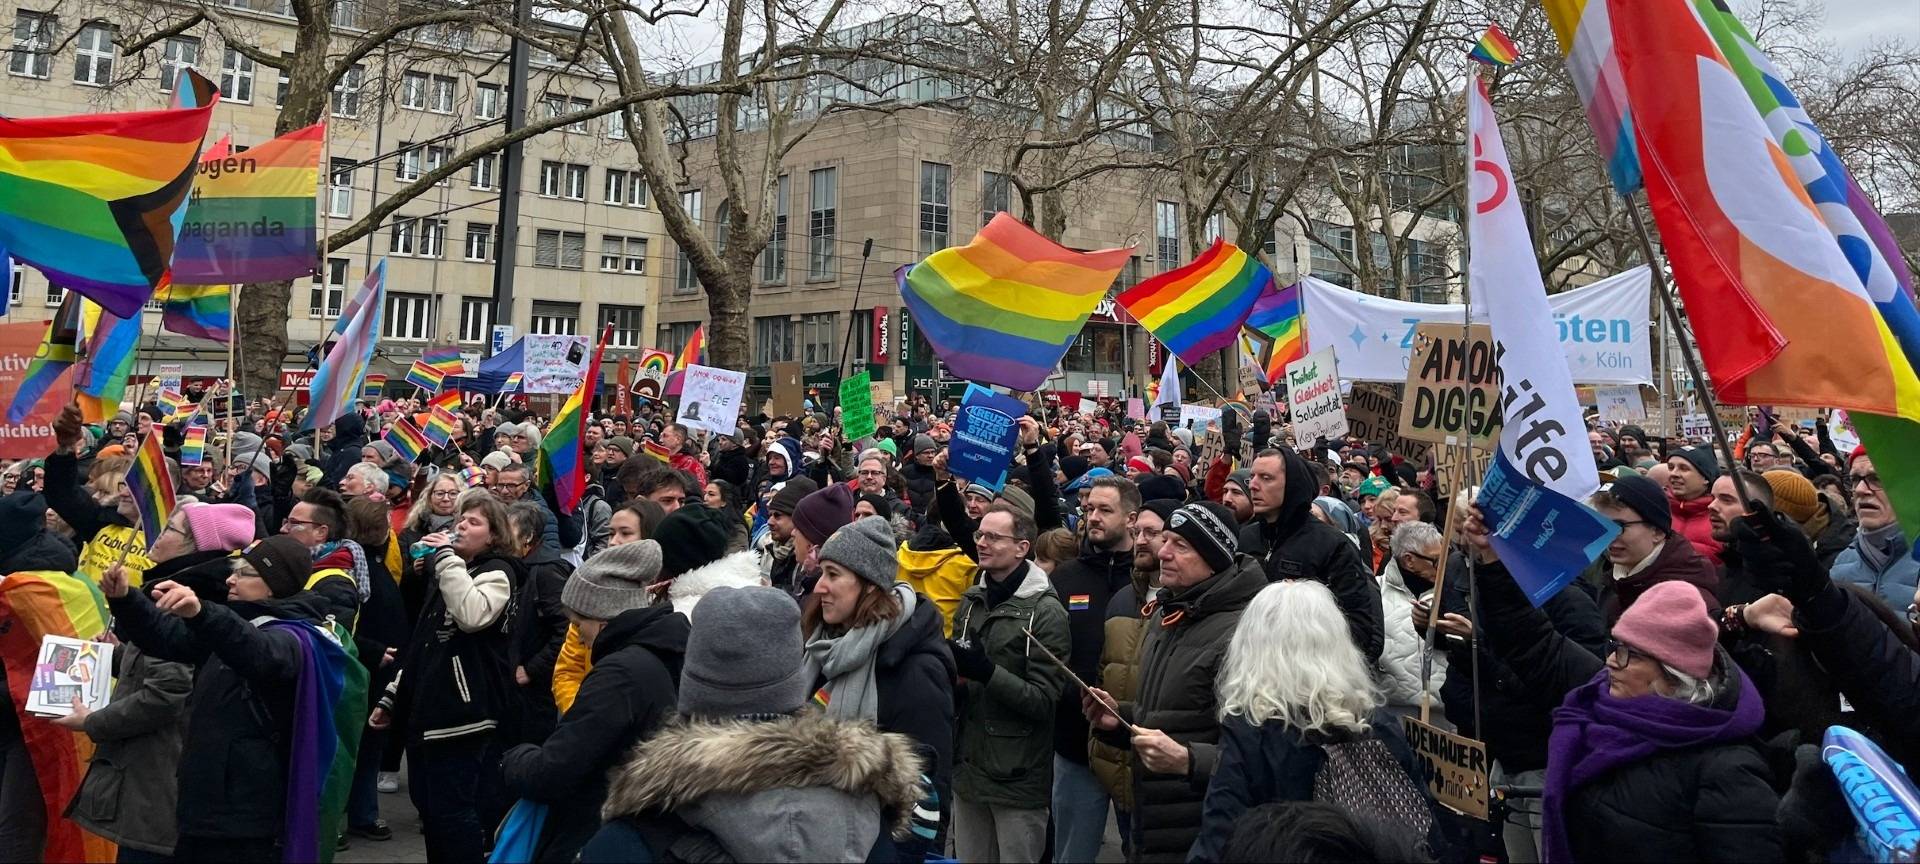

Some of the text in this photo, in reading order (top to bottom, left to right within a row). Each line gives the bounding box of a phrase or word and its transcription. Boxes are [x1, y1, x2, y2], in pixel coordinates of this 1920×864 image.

[1597, 351, 1632, 369] Köln
[969, 406, 1011, 425] KREUZE
[1412, 386, 1504, 437] DIGGA
[967, 416, 1007, 437] SETZEN
[968, 425, 1001, 443] STATT
[1405, 720, 1486, 775] ADENAUER
